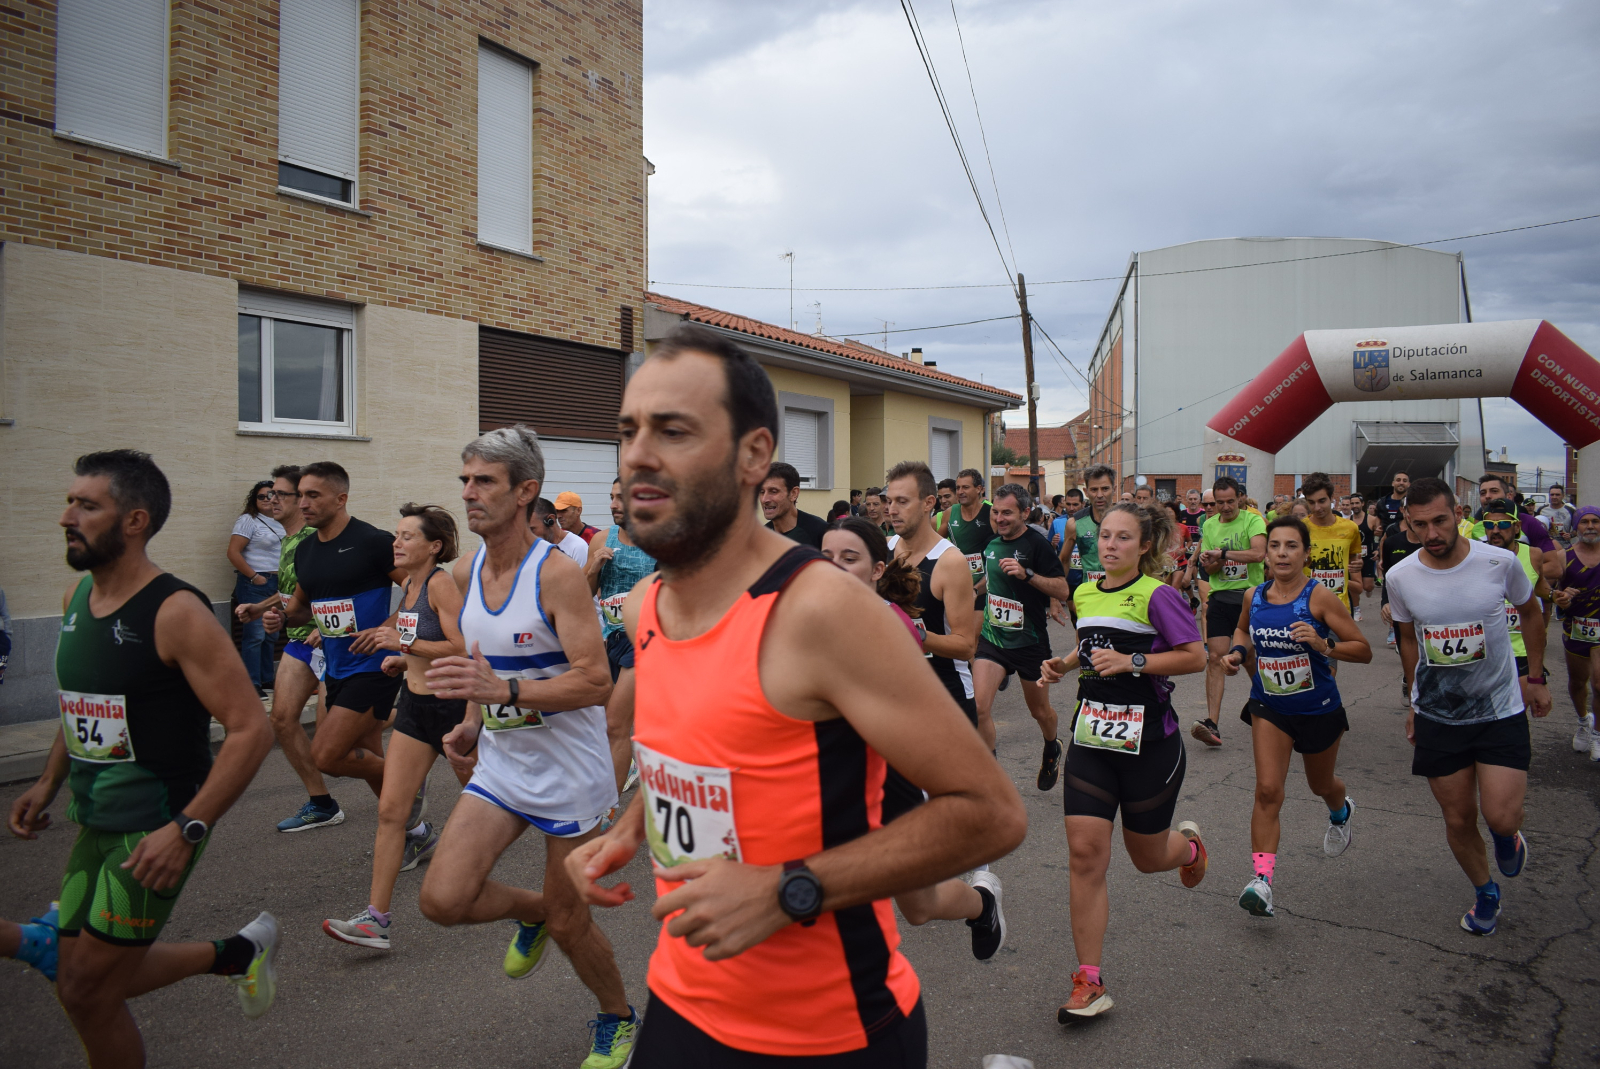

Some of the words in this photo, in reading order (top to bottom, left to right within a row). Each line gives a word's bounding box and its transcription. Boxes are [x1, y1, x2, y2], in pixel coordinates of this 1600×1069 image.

[1392, 343, 1467, 360] Diputación
[1537, 354, 1565, 376] CON
[1392, 373, 1405, 382] de
[1410, 368, 1482, 381] Salamanca
[1227, 415, 1251, 436] CON
[1249, 405, 1265, 417] EL
[1263, 360, 1311, 405] DEPORTE
[1530, 368, 1600, 430] DEPORTISTA
[1225, 566, 1238, 576] 29
[1321, 579, 1335, 588] 30
[311, 602, 353, 616] bedunia
[988, 596, 1023, 612] bedunia
[324, 614, 340, 629] 60
[994, 607, 1011, 622] 31
[1256, 627, 1301, 640] apach
[1424, 625, 1484, 640] bedunia
[1581, 626, 1596, 637] 56
[1442, 639, 1468, 656] 64
[1258, 657, 1310, 671] bedunia
[1273, 670, 1296, 687] 10
[59, 694, 124, 720] bedunia
[1080, 703, 1143, 723] bedunia
[76, 717, 104, 746] 54
[1090, 719, 1129, 741] 122
[636, 751, 730, 814] bedunia
[655, 796, 696, 854] 70
